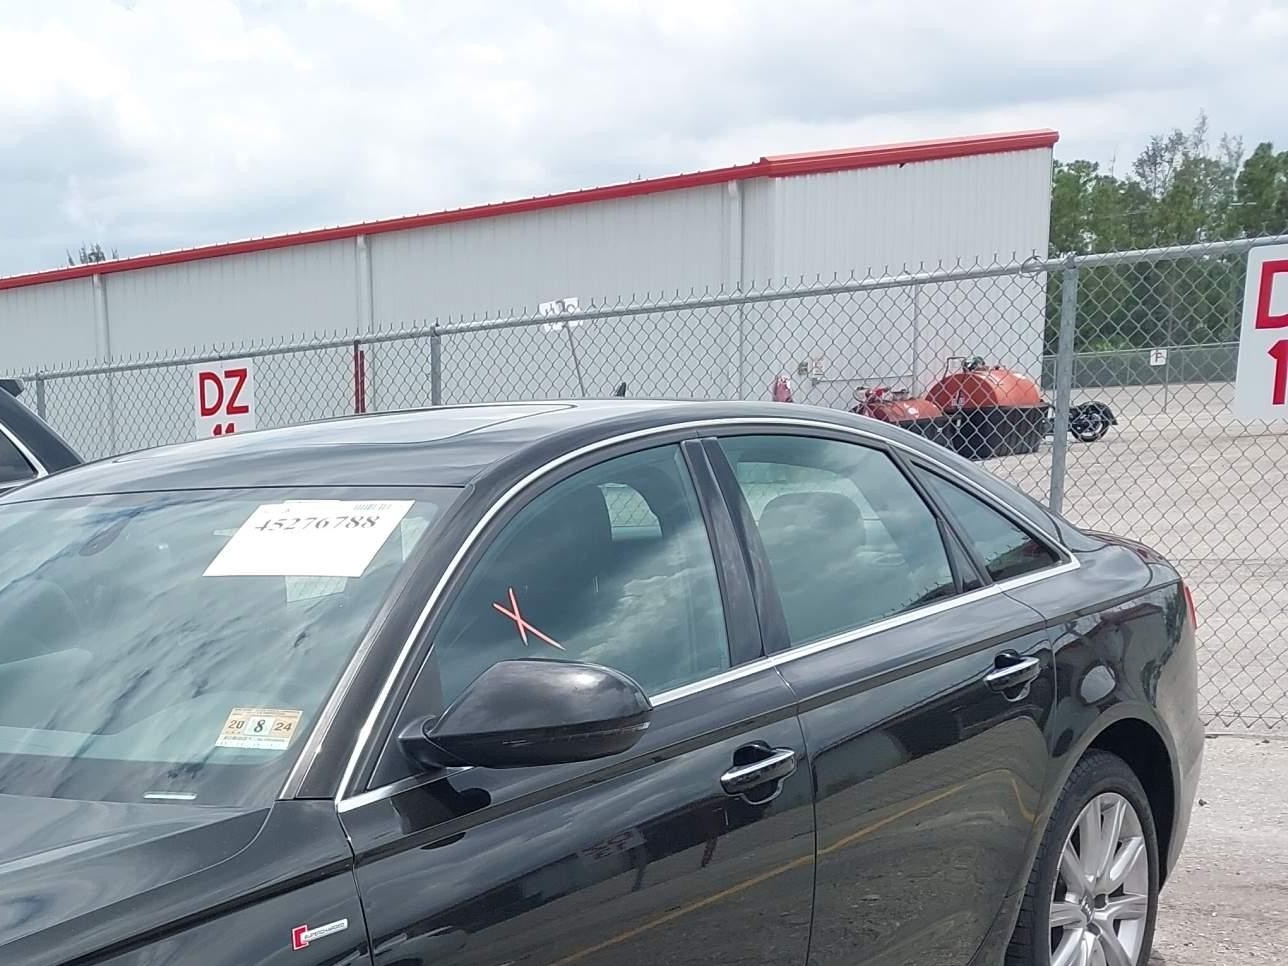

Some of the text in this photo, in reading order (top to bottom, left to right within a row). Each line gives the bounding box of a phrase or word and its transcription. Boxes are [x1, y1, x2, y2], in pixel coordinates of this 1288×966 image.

[199, 368, 249, 416] DZ
[255, 515, 380, 531] 45276788
[228, 719, 292, 733] 20 8 24
